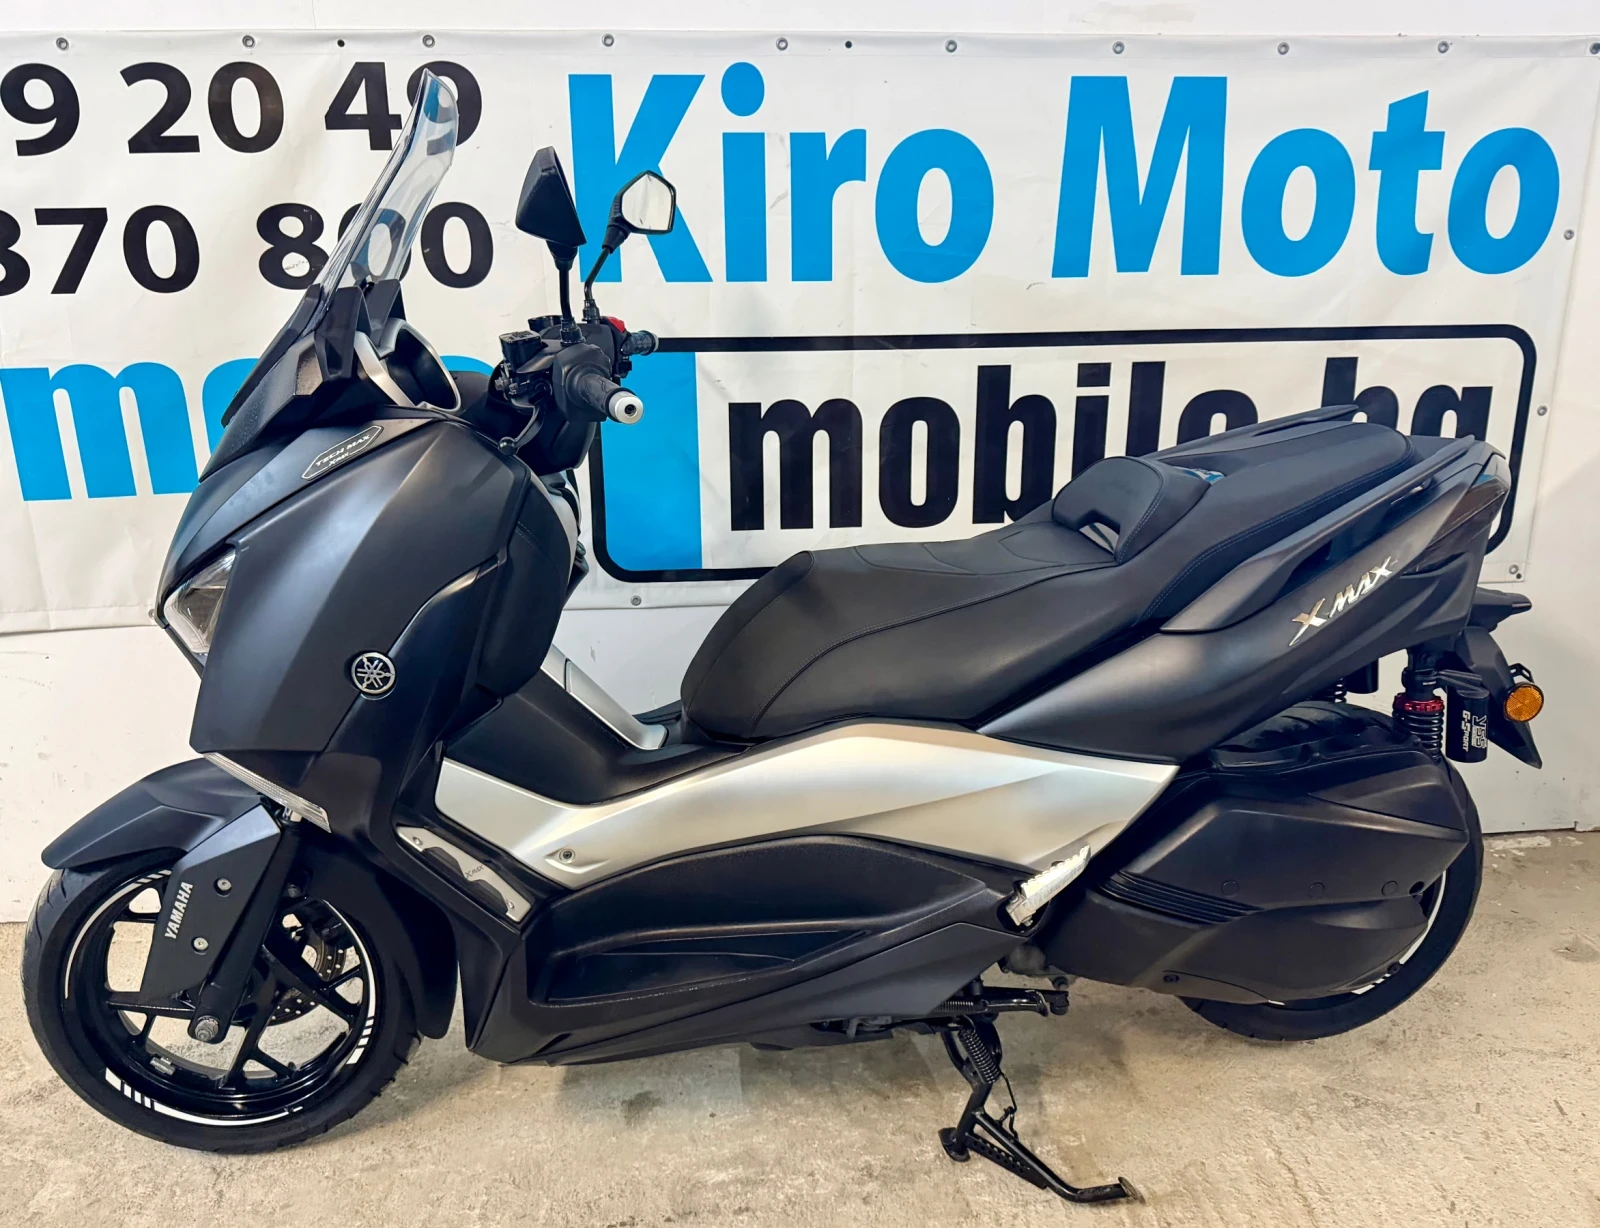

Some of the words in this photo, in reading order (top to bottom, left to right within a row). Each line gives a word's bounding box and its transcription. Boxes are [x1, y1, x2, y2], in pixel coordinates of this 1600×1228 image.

[0, 63, 80, 156] 9
[120, 61, 284, 153] 20
[568, 61, 994, 284] Kiro
[1051, 75, 1560, 278] Moto
[315, 447, 344, 467] TECH
[346, 434, 370, 450] MAX
[1472, 714, 1488, 749] YSS
[164, 881, 194, 939] YAMAHA
